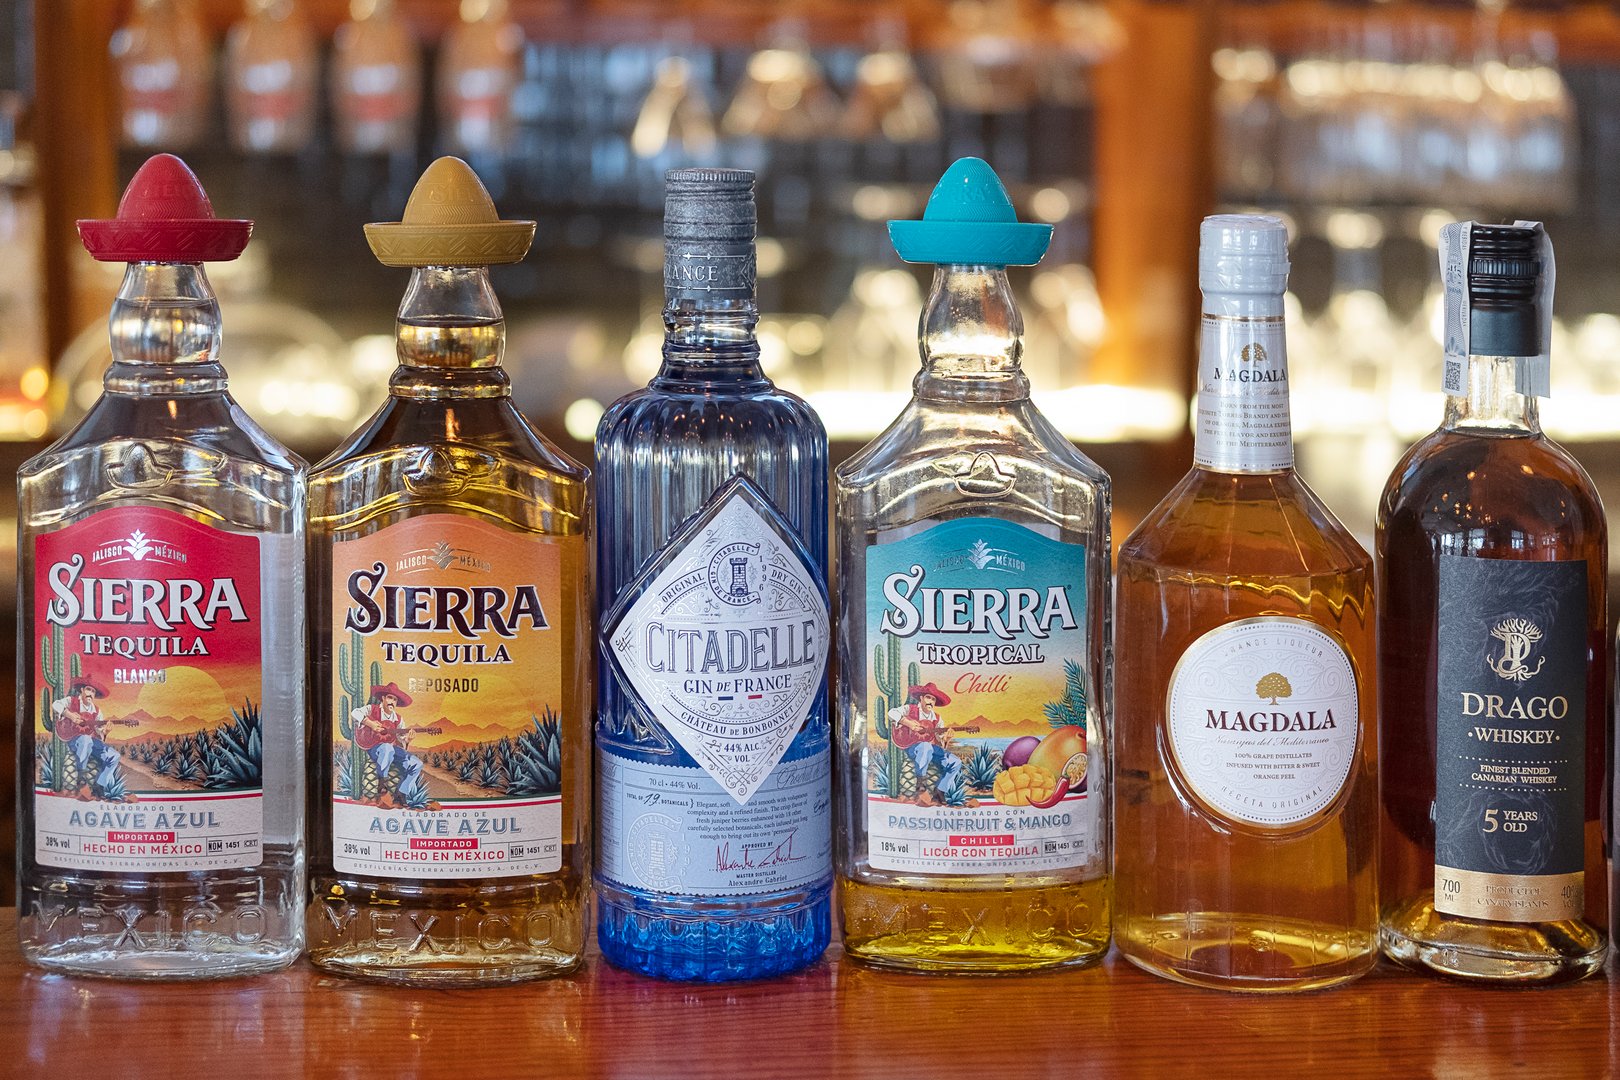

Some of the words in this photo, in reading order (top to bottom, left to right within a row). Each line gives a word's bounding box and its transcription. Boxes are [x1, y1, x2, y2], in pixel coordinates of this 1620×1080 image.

[1239, 439, 1287, 448] MEDITERRANEAN
[92, 545, 122, 563] JALISCO
[154, 545, 187, 563] MÉXICO
[713, 544, 752, 565] CITADELLE
[396, 555, 427, 572] JALISCO
[996, 554, 1026, 571] MÉXICO
[771, 569, 789, 582] DRY
[46, 553, 249, 631] SIERRA
[661, 573, 705, 603] ORIGINAL
[345, 561, 549, 640] SIERRA
[722, 593, 752, 604] FRANCE
[880, 564, 1078, 640] SIERRA
[79, 632, 211, 660] TEQUILA
[645, 620, 815, 674] CITADELLE
[1276, 638, 1323, 658] LIQUEUR
[381, 641, 514, 668] TEQUILA
[916, 642, 1045, 665] TROPICAL
[113, 668, 167, 684] BLANCO
[683, 679, 713, 694] GIN
[716, 681, 731, 693] DE
[733, 674, 792, 693] FRANCE
[953, 672, 1013, 694] Chilli
[1461, 692, 1569, 720] DRAGO
[680, 711, 726, 735] CHÂTEAU
[729, 728, 740, 736] DE
[742, 706, 794, 736] BONBONNET
[1205, 709, 1337, 733] MAGDALA
[1256, 736, 1272, 746] del
[1272, 735, 1330, 747] Mediterráneo
[1474, 727, 1555, 744] WHISKEY
[723, 743, 743, 753] 44%
[743, 742, 762, 752] ALC.
[734, 754, 750, 763] VOL
[1234, 752, 1252, 760] 100%
[1480, 764, 1510, 774] FINEST
[1511, 766, 1550, 775] BLENDED
[648, 777, 657, 786] 70
[657, 779, 664, 787] cl
[669, 780, 685, 789] 44%
[686, 781, 701, 790] Vol.
[1471, 773, 1517, 784] CANARIAN
[1520, 775, 1557, 784] WHISKEY
[661, 799, 689, 807] BOTANICALS
[1221, 785, 1264, 808] RECETA
[1272, 786, 1323, 808] ORIGINAL
[99, 804, 165, 812] ELABORADO
[170, 804, 184, 812] DE
[696, 801, 719, 809] Elegant,
[402, 811, 468, 819] ELABORADO
[687, 808, 718, 817] complexity
[69, 810, 147, 830] AGAVE
[154, 811, 222, 830] AZUL
[710, 817, 730, 825] juniper
[750, 814, 774, 822] enhanced
[888, 815, 1002, 832] PASSIONFRUIT
[1004, 817, 1016, 831] &
[1019, 813, 1072, 829] MANGO
[1482, 809, 1499, 833] 5
[1503, 810, 1538, 821] YEARS
[369, 816, 450, 837] AGAVE
[457, 817, 522, 836] AZUL
[687, 825, 711, 833] carefully
[735, 823, 763, 831] botanicals,
[763, 821, 775, 829] each
[1503, 822, 1528, 833] OLD
[45, 836, 59, 848] 38%
[60, 838, 71, 849] vol
[113, 833, 169, 841] IMPORTADO
[700, 833, 720, 841] enough
[727, 832, 742, 840] bring
[960, 837, 1004, 845] CHILLI
[83, 843, 125, 854] HECHO
[129, 845, 145, 854] EN
[150, 842, 203, 855] MÉXICO
[208, 840, 223, 852] NOM
[225, 841, 240, 849] 1451
[344, 843, 358, 855] 38%
[359, 845, 371, 856] vol
[416, 840, 472, 848] IMPORTADO
[881, 841, 896, 852] 18%
[897, 844, 909, 853] vol
[1044, 841, 1057, 853] NOM
[1057, 842, 1070, 850] 1451
[385, 850, 428, 860] HECHO
[433, 851, 449, 861] EN
[454, 849, 505, 861] MÉXICO
[510, 845, 524, 857] NOM
[526, 846, 540, 854] 1451
[923, 845, 958, 857] LICÓR
[962, 848, 987, 858] CON
[990, 846, 1039, 858] TEQUILA
[736, 870, 754, 878] MASTER
[755, 870, 777, 878] DISTILLER
[727, 878, 764, 887] Alexandre
[766, 875, 788, 883] Gabriel
[1442, 879, 1461, 894] 700
[1477, 897, 1512, 908] CANARY
[1515, 899, 1549, 908] ISLANDS
[321, 904, 555, 952] MEXICO
